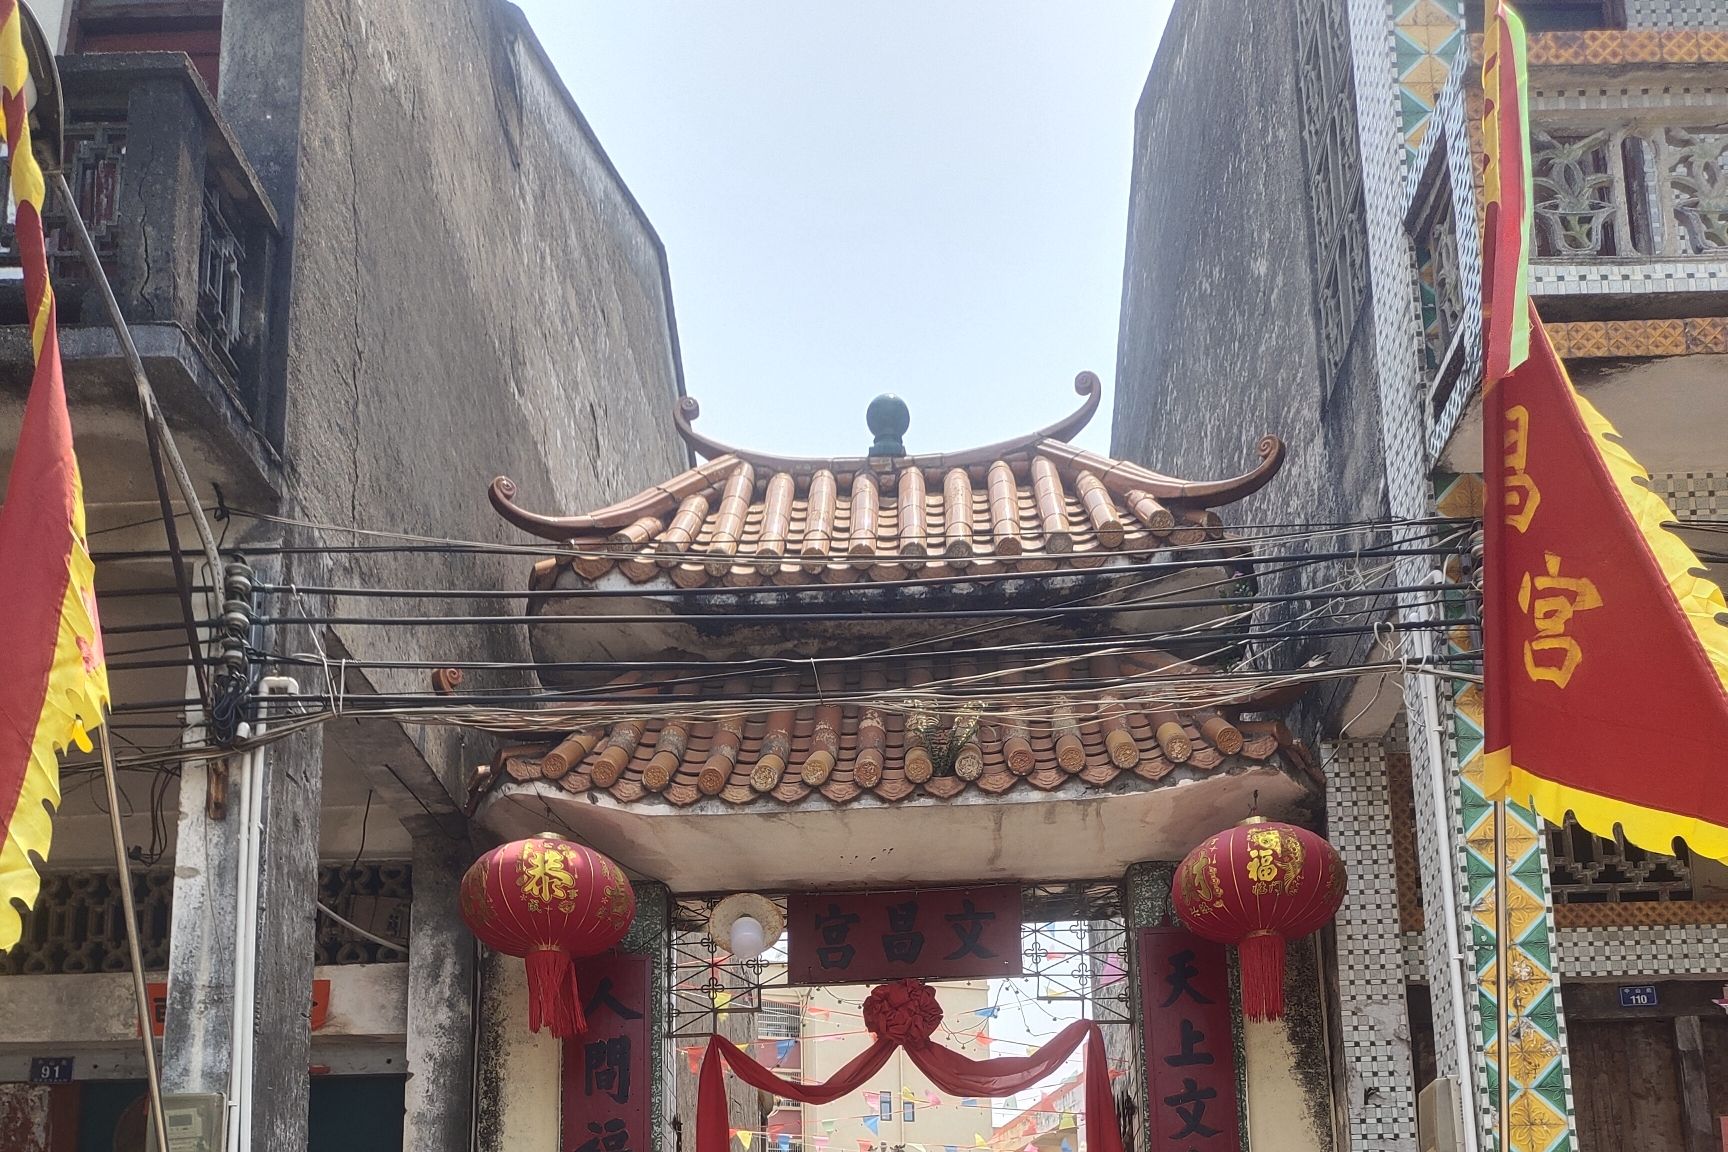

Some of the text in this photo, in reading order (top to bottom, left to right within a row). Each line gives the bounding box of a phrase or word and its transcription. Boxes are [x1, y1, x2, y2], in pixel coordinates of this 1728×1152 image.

[1247, 849, 1278, 882] 福
[1630, 995, 1647, 1004] 110
[41, 1065, 60, 1078] 91
